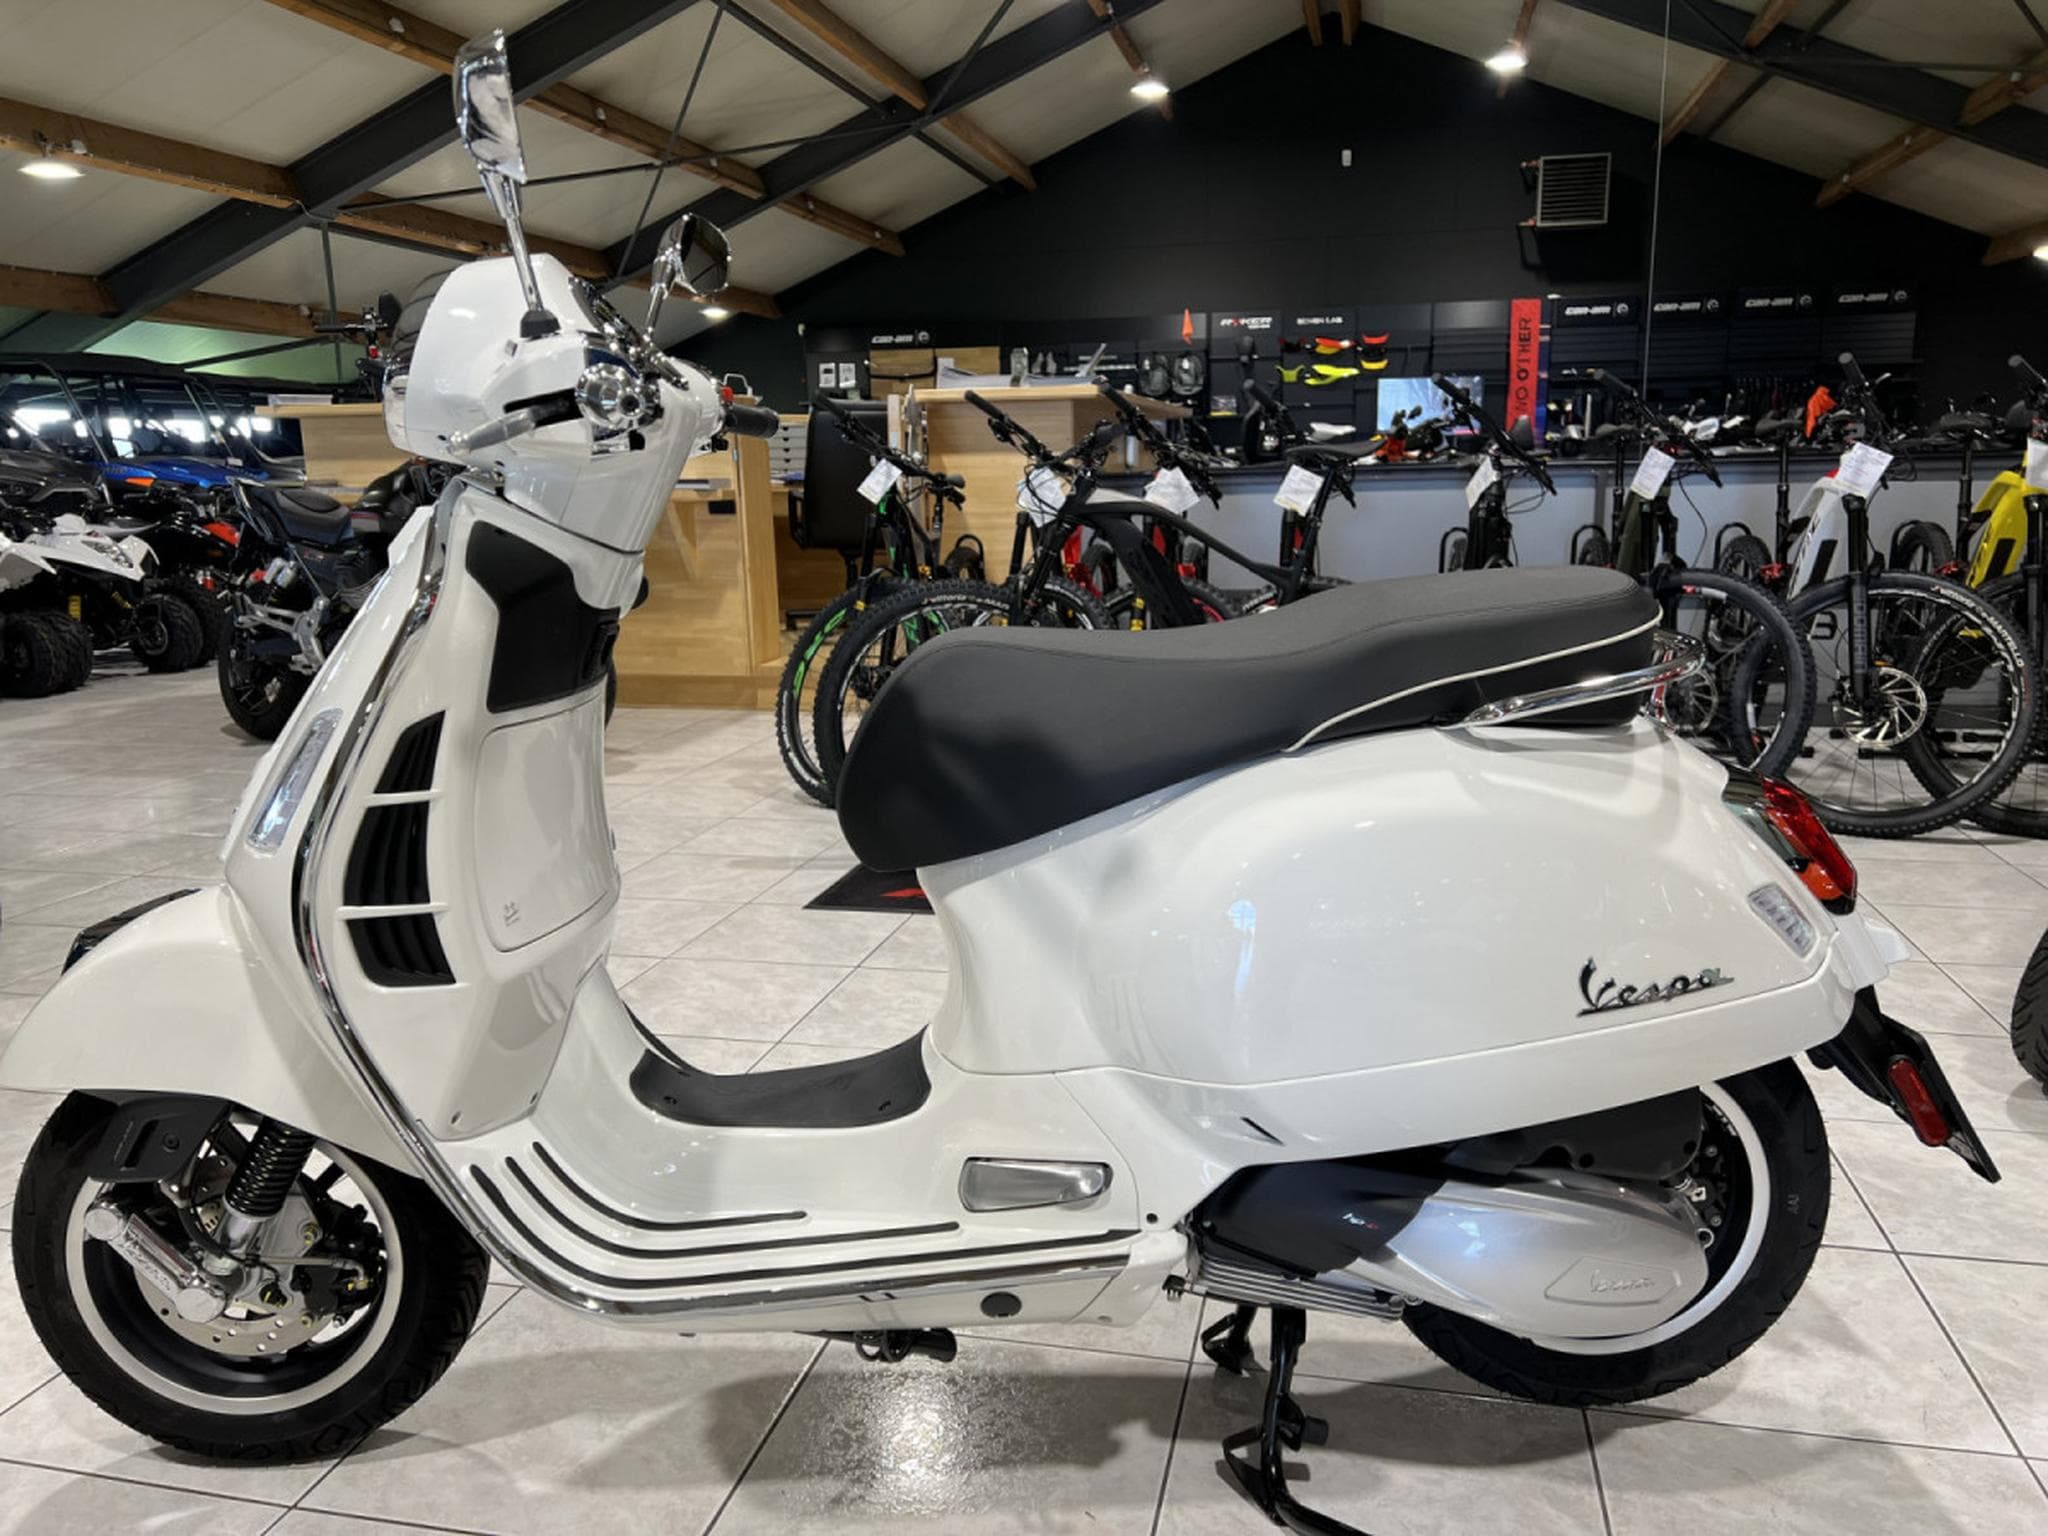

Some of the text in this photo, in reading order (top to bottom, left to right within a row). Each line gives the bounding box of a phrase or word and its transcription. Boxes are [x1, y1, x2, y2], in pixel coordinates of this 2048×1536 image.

[1515, 317, 1532, 413] NO OTHER
[1576, 957, 1735, 1017] Vespa
